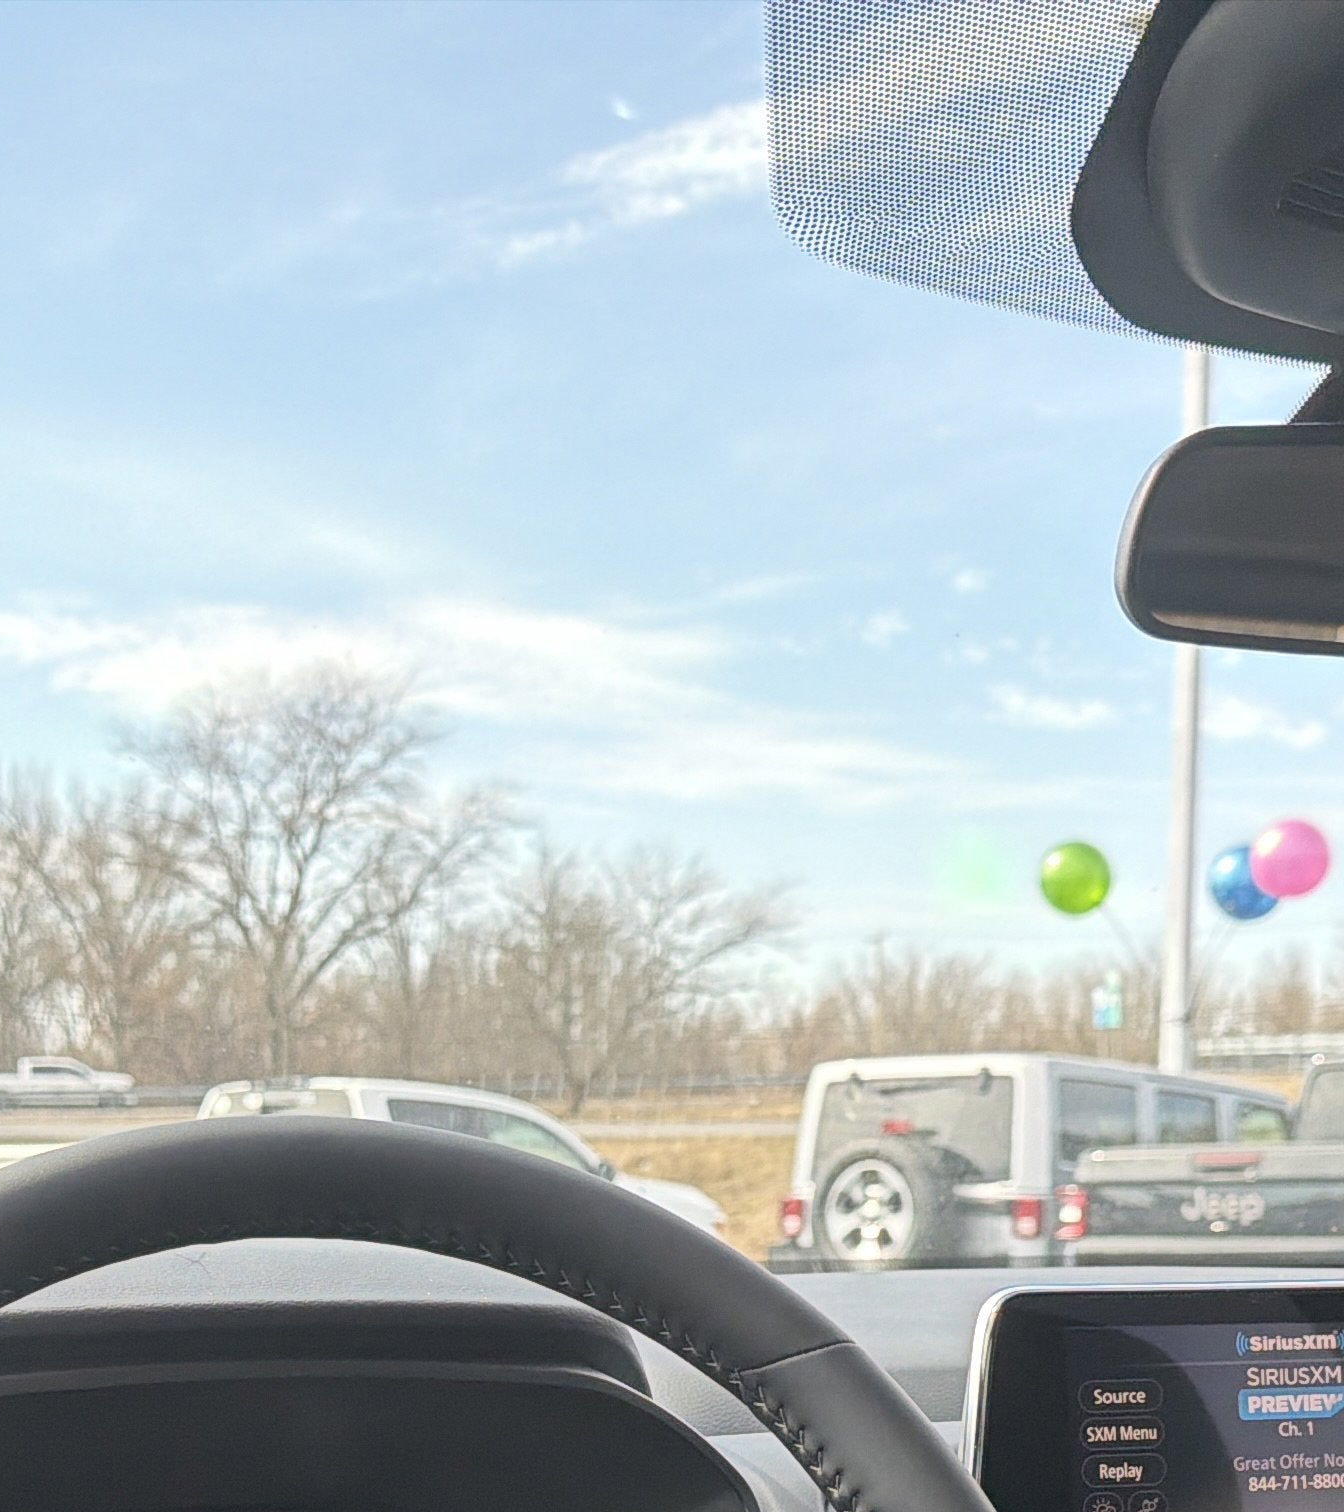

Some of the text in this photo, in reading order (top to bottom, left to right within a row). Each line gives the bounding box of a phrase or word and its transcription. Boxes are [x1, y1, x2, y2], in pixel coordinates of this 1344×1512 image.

[1180, 1186, 1265, 1227] Jeep
[1246, 1365, 1343, 1386] SIRIUSXM
[1093, 1389, 1147, 1405] Source
[1247, 1392, 1344, 1414] PREVIEW
[1086, 1425, 1158, 1443] SXM Menu
[1278, 1420, 1315, 1438] Ch. 1
[1099, 1462, 1144, 1482] Replay
[1233, 1456, 1277, 1473] Great
[1280, 1453, 1320, 1470] Offer
